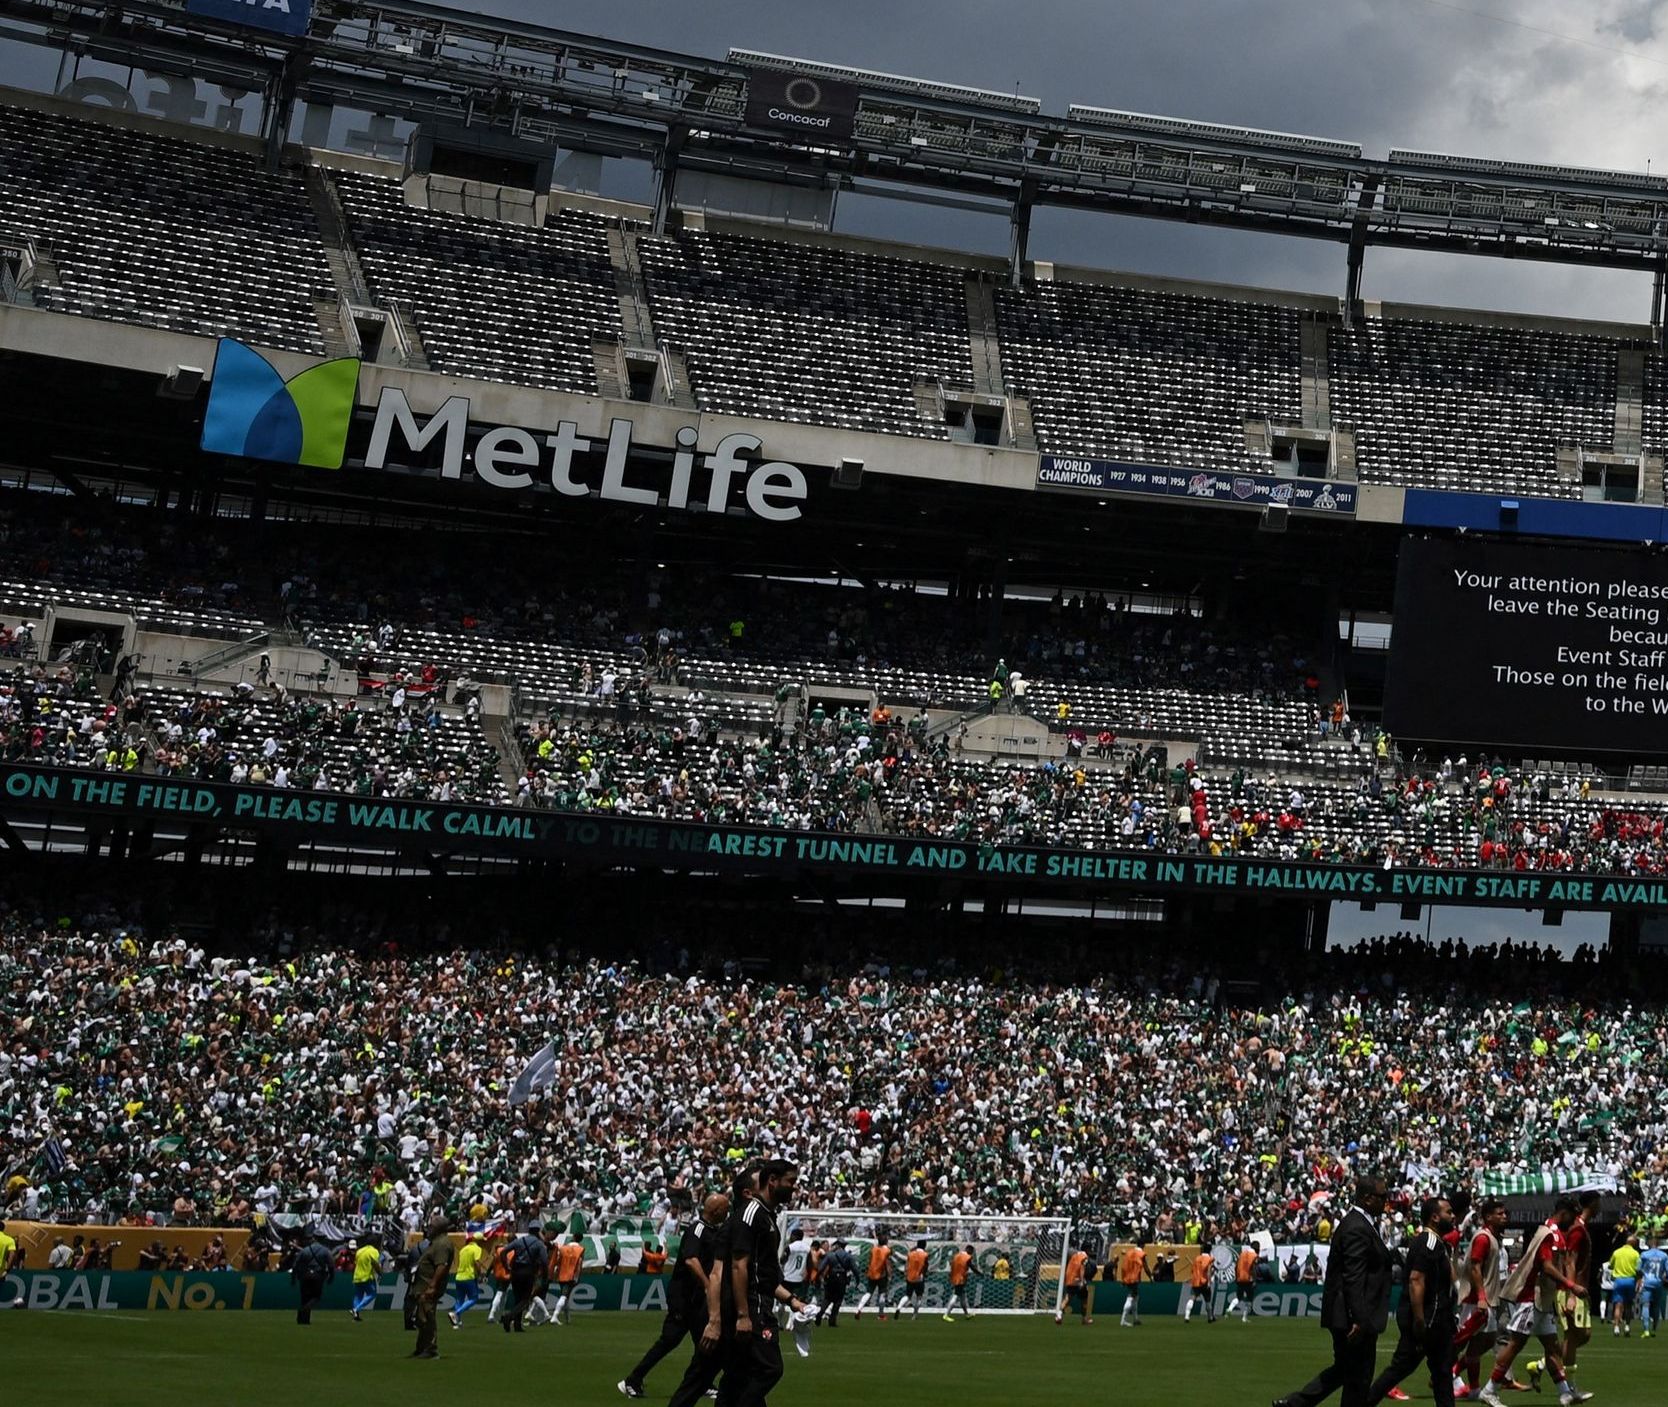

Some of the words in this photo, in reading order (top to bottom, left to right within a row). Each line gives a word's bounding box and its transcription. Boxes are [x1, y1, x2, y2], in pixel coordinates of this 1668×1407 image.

[768, 108, 831, 127] Concacaf
[364, 386, 808, 522] MetLife
[1053, 458, 1092, 472] WORLD
[1039, 470, 1102, 486] CHAMPIONS
[1455, 570, 1502, 588] Your
[1509, 577, 1599, 594] attention
[1489, 595, 1539, 613] leave
[1547, 599, 1578, 616] the
[1586, 602, 1659, 625] Seating
[1558, 647, 1611, 665] Event
[1619, 650, 1666, 667] Staff
[1493, 666, 1554, 685] Those
[1563, 674, 1587, 687] on
[1596, 672, 1626, 689] the
[1586, 697, 1605, 711] to
[1614, 696, 1644, 713] the
[6, 773, 59, 798] ON
[73, 778, 126, 804] THE
[138, 785, 221, 813] FIELD,
[236, 793, 336, 823] PLEASE
[350, 805, 432, 831] WALK
[797, 838, 898, 865] TUNNEL
[907, 847, 966, 869] AND
[1046, 855, 1147, 880] SHELTER
[1156, 862, 1185, 882] IN
[1195, 863, 1237, 885] THE
[1247, 866, 1381, 893] HALLWAYS.
[1392, 874, 1467, 896] EVENT
[1475, 877, 1540, 897] STAFF
[1549, 881, 1593, 902] ARE
[146, 1276, 227, 1310] No.
[240, 1276, 256, 1309] 1
